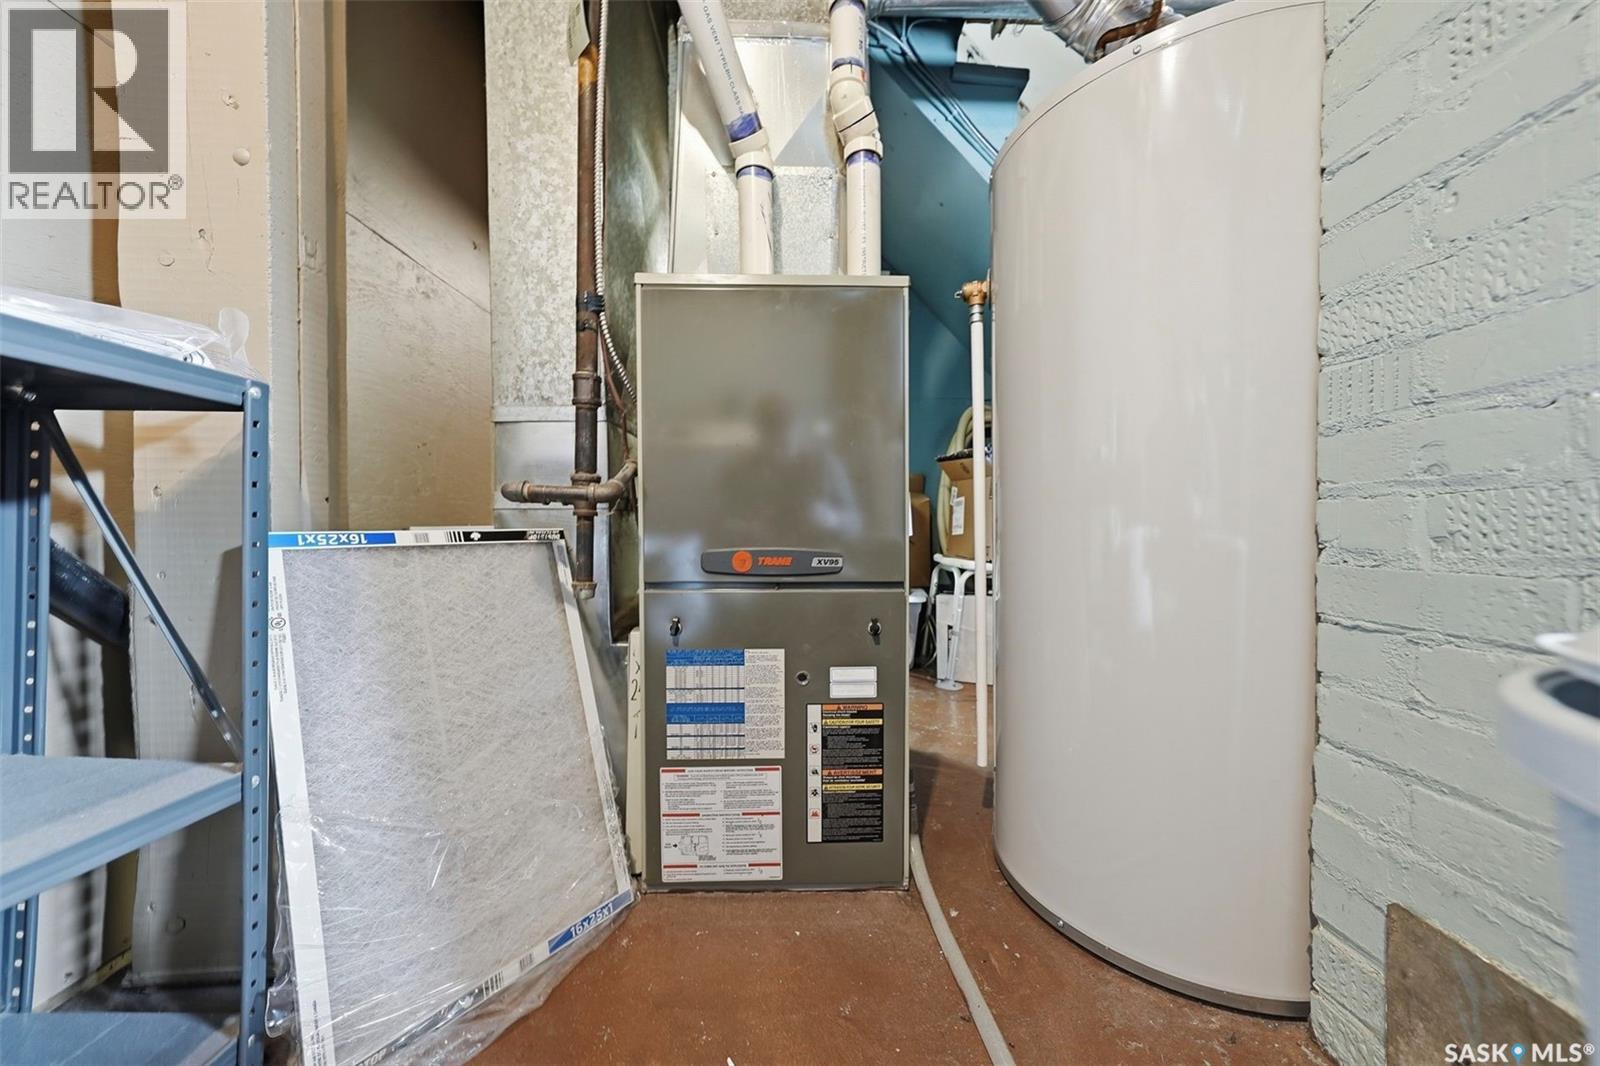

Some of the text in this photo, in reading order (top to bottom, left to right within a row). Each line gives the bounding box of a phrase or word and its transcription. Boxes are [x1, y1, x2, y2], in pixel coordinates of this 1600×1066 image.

[710, 24, 721, 46] VENT
[757, 556, 793, 566] TRANE
[816, 558, 839, 566] XV95
[570, 903, 614, 938] 16x25x1
